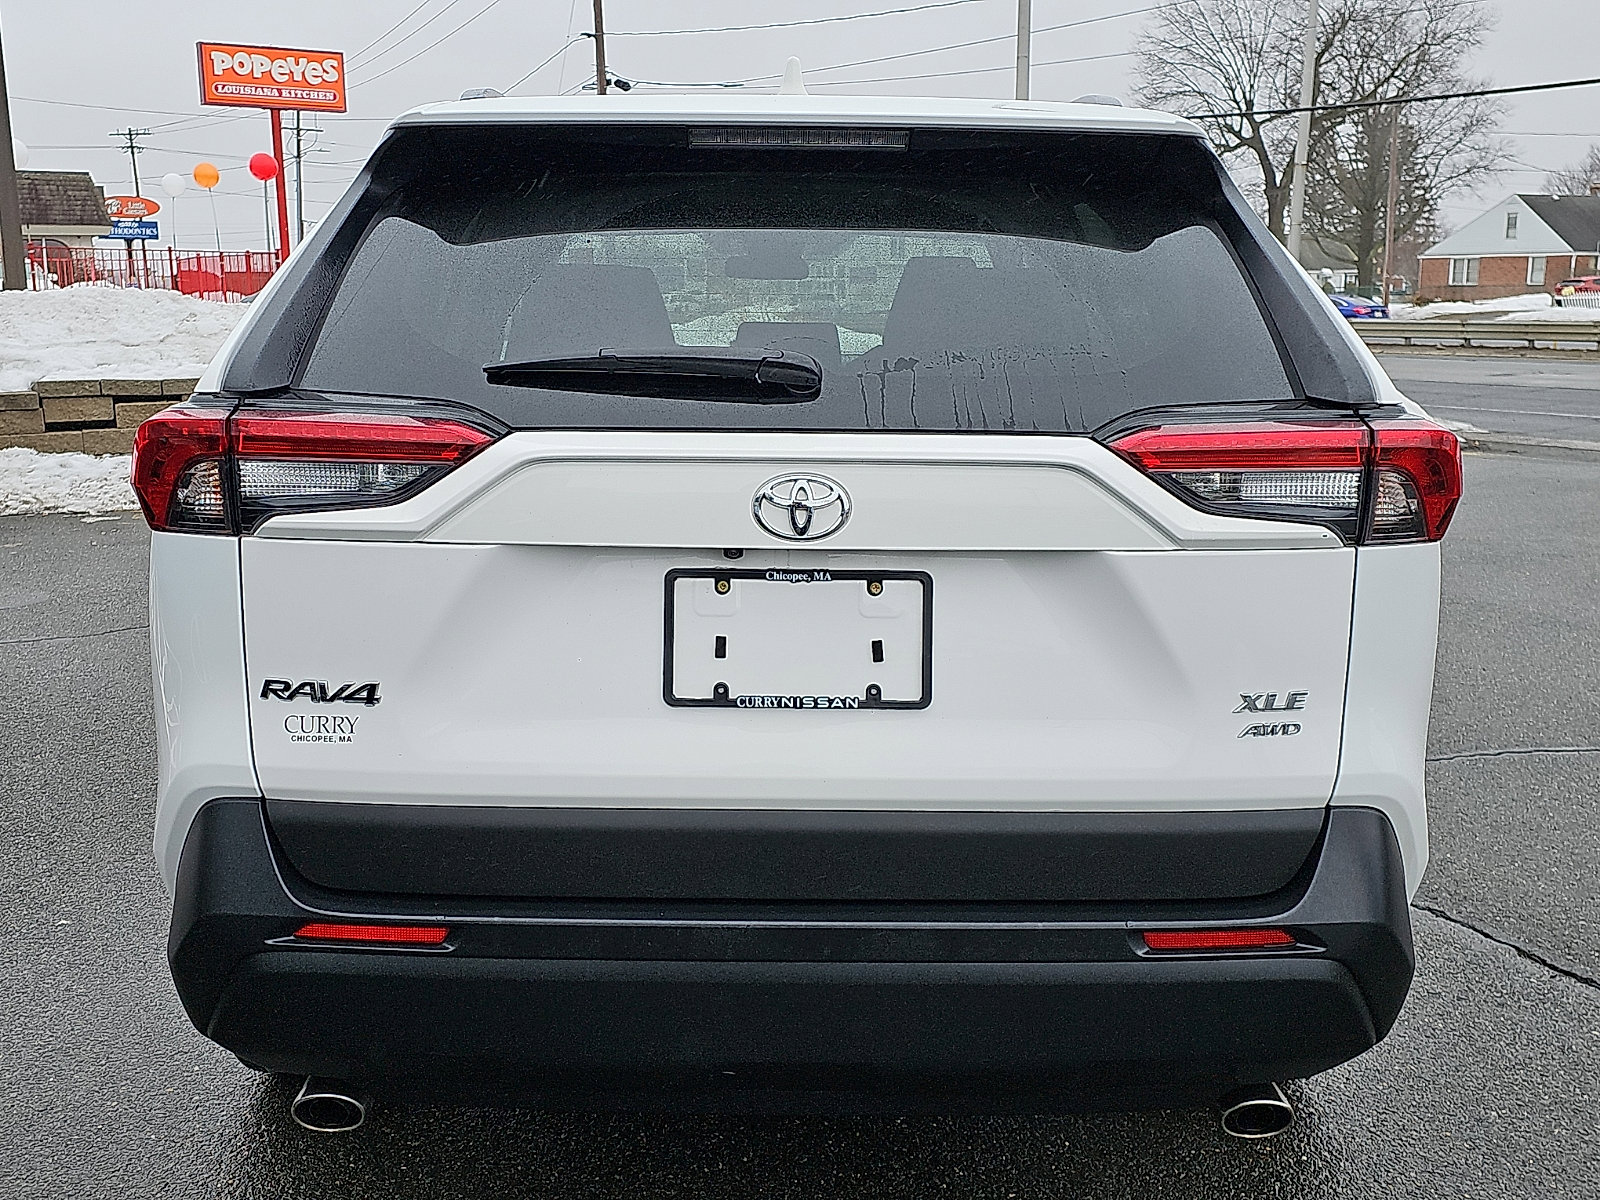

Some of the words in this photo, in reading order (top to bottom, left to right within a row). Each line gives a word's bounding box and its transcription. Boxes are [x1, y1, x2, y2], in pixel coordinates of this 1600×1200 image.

[217, 84, 280, 97] LOUISIANA
[281, 88, 335, 100] KITCHEN
[765, 571, 812, 583] Chicopee,
[813, 571, 832, 582] MA
[260, 678, 382, 707] RAV4
[737, 695, 781, 709] CURRY
[781, 697, 859, 709] NISSAN
[1232, 690, 1308, 713] XLE
[284, 714, 360, 734] CURRY
[1237, 721, 1302, 739] AWD
[290, 735, 337, 744] CHICOPEE,
[338, 735, 353, 743] MA
